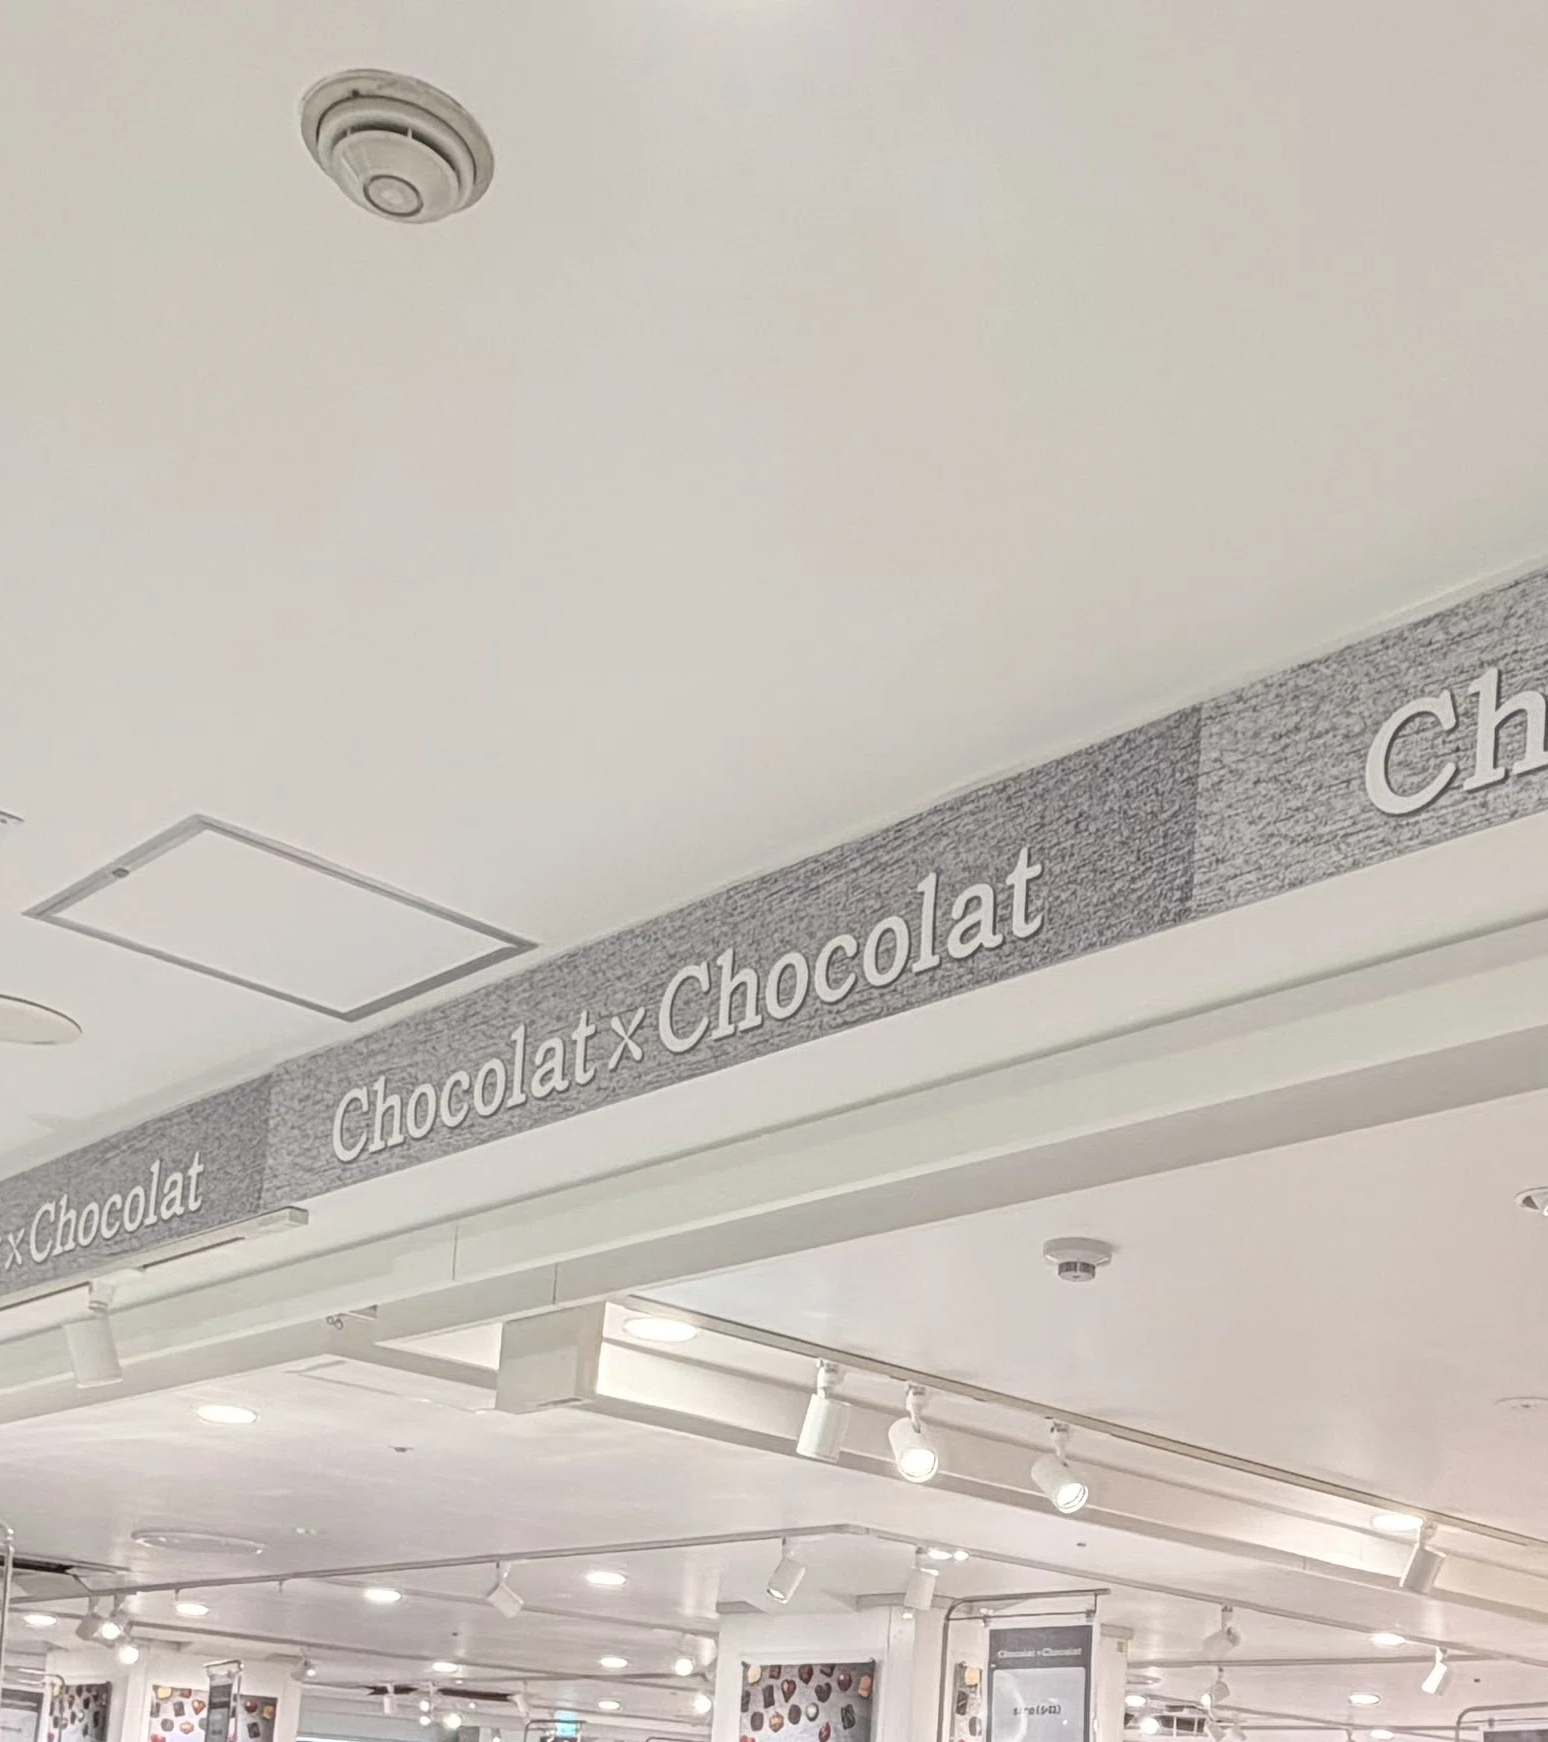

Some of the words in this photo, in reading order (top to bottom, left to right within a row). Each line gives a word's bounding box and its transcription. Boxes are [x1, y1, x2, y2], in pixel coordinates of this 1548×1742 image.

[331, 1008, 594, 1164] Chocolat
[657, 845, 1046, 1056] Chocolat
[28, 1150, 205, 1263] Chocolat
